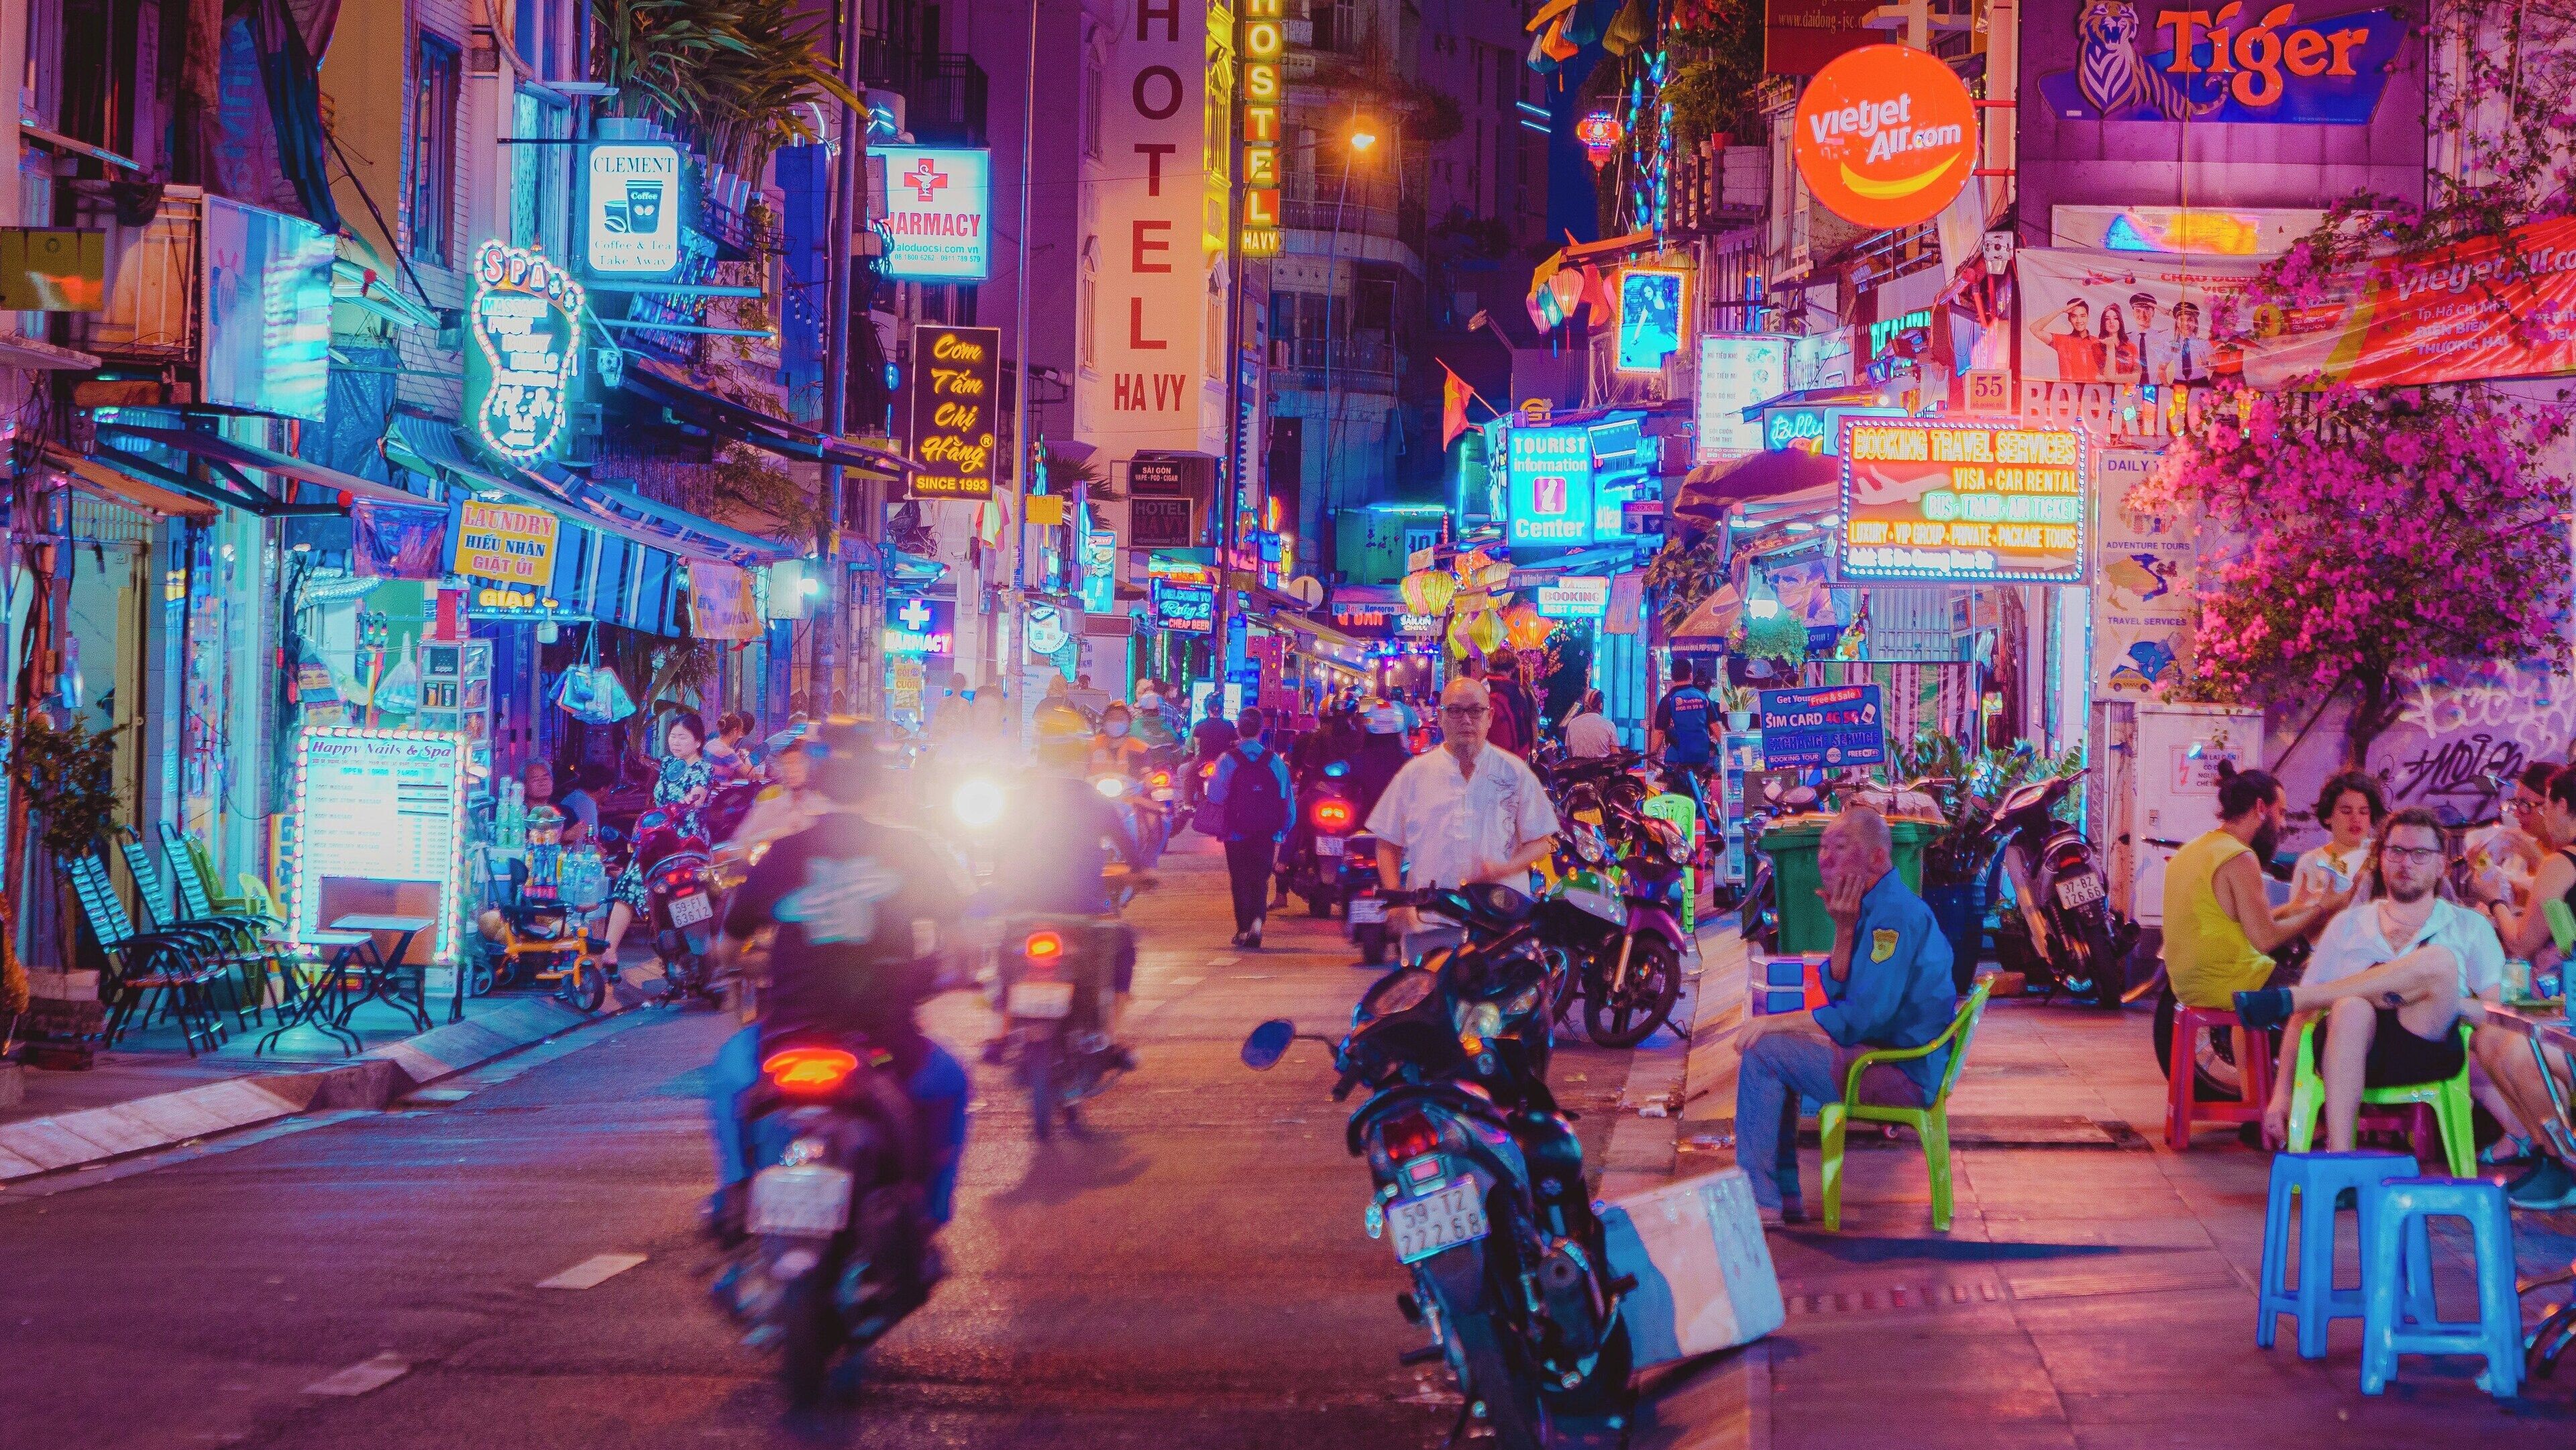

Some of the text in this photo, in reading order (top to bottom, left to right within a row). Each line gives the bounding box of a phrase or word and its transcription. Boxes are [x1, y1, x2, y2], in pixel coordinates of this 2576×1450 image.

[2156, 1, 2369, 107] Tiger
[594, 156, 674, 173] CLEMENT
[631, 192, 657, 201] Coffee
[870, 212, 981, 237] HARMACY
[595, 240, 633, 250] Coffee
[651, 240, 672, 250] Tea
[1244, 232, 1277, 249] HAVY
[485, 248, 546, 290] SPA
[598, 254, 668, 267] Take Away
[933, 333, 982, 360] Cơm
[931, 368, 983, 394] Tấm
[1975, 376, 2004, 398] 55
[1114, 374, 1186, 411] HAVY
[934, 402, 979, 432] Chị
[921, 435, 985, 473] Hằng
[1514, 437, 1587, 454] TOURIST
[1853, 427, 2077, 465] BOOKING TRAVEL SERVICES
[1514, 458, 1587, 473] information
[2108, 459, 2149, 471] DAILY
[916, 477, 987, 492] SINCE 1993
[1953, 467, 2078, 492] VISA CAR RENTAL
[1928, 494, 1953, 518] BUS
[1962, 494, 2000, 519] TRAIN
[2008, 495, 2030, 518] AIR
[464, 506, 554, 537] LAUNDRY
[1515, 518, 1585, 537] Center
[1849, 521, 1888, 545] LUXURY
[1913, 522, 1945, 545] GROUP
[1951, 524, 1992, 547] PRIVATE
[1997, 525, 2043, 549] PACKAGE
[2043, 526, 2076, 549] TOURS
[465, 534, 545, 557] HIẾU NHÂN
[2106, 541, 2190, 551] ADVENTURE TOURS
[472, 555, 511, 575] GIẶT
[1161, 589, 1212, 602] WELCOME TO
[1544, 592, 1600, 602] BOOKING
[1169, 618, 1210, 630] CHEAP BEER
[2108, 616, 2188, 626] TRAVEL SERVICES
[1777, 691, 1856, 706] Get Your Free & Sale
[1765, 713, 1787, 729] SIM
[1790, 712, 1823, 727] CARD
[313, 741, 451, 759] Happy Nails & Spa
[1770, 755, 1800, 763] BOOKING
[1802, 753, 1819, 762] TOUR
[2065, 886, 2100, 906] 126.66
[1403, 1212, 1481, 1258] 222.68
